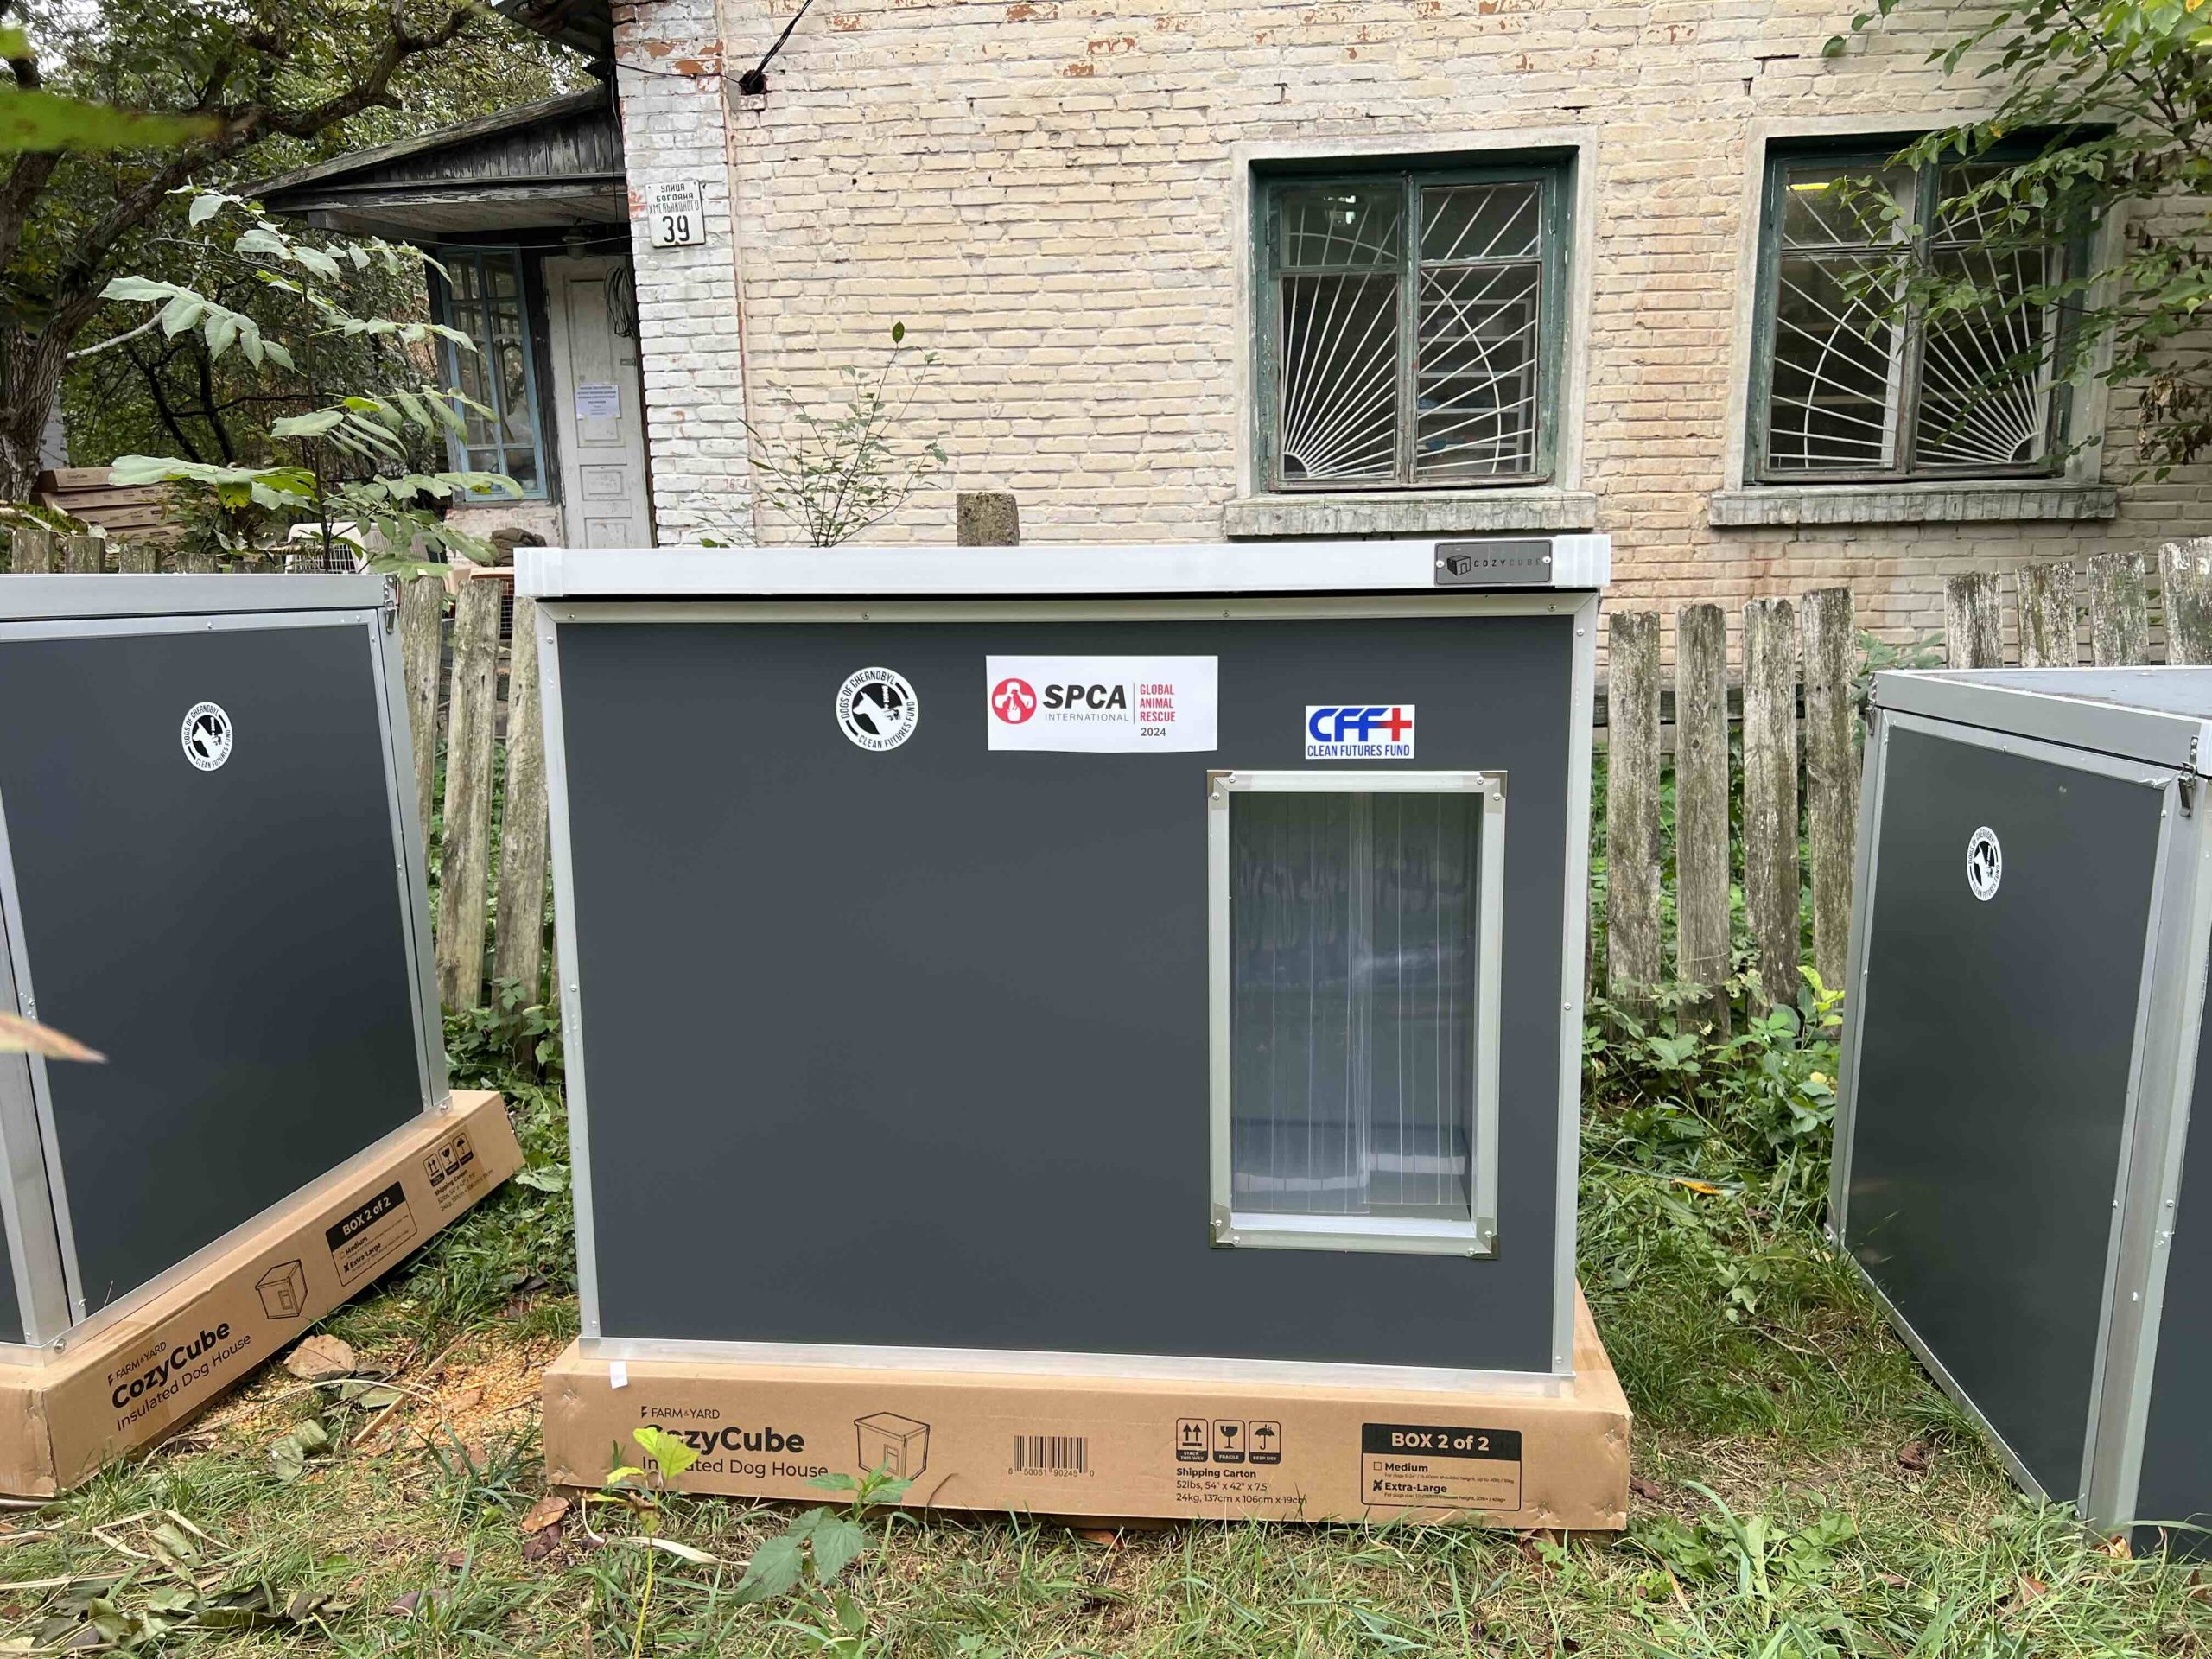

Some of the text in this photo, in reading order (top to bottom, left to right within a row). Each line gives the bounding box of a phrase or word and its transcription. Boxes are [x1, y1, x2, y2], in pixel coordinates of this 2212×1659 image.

[661, 183, 685, 193] УЛИЦА
[657, 193, 694, 202] БОГДАНА
[663, 215, 690, 243] 39
[840, 671, 895, 719] DOGS OF CHERNOBYL
[1043, 684, 1127, 709] SPCA
[1140, 684, 1174, 695] GLOBAL
[1140, 698, 1173, 709] ANIMAL
[186, 717, 193, 726] OF
[190, 705, 219, 719] CHERNOBYL
[1045, 713, 1129, 721] INTERNATIONAL
[1140, 711, 1175, 722] RESCUE
[859, 701, 915, 748] CLEAN FUTURES FUND
[1141, 728, 1166, 737] 2024
[196, 758, 211, 768] CLEAN
[213, 747, 229, 767] FUTURES
[1307, 745, 1409, 756] CLEAN FUTURES FUND
[342, 1214, 365, 1236] BOX
[365, 1209, 372, 1220] 2
[373, 1200, 383, 1214] of
[383, 1196, 391, 1207] 2
[346, 1236, 368, 1255] Medium
[350, 1243, 381, 1268] Extra-Large
[111, 1322, 230, 1408] CozyCube
[117, 1335, 251, 1431] Insulated Dog House
[1391, 1432, 1489, 1451] BOX 2 of 2
[642, 1456, 829, 1478] Inated Dog House
[1176, 1468, 1256, 1478] Shipping Carton
[1385, 1462, 1428, 1472] Medium
[1176, 1480, 1203, 1491] 52lbs,
[1205, 1481, 1219, 1490] 54"
[1230, 1482, 1244, 1491] 42"
[1385, 1482, 1447, 1494] Extra-Large
[1176, 1493, 1202, 1503] 24kg,
[1204, 1493, 1232, 1503] 137cm
